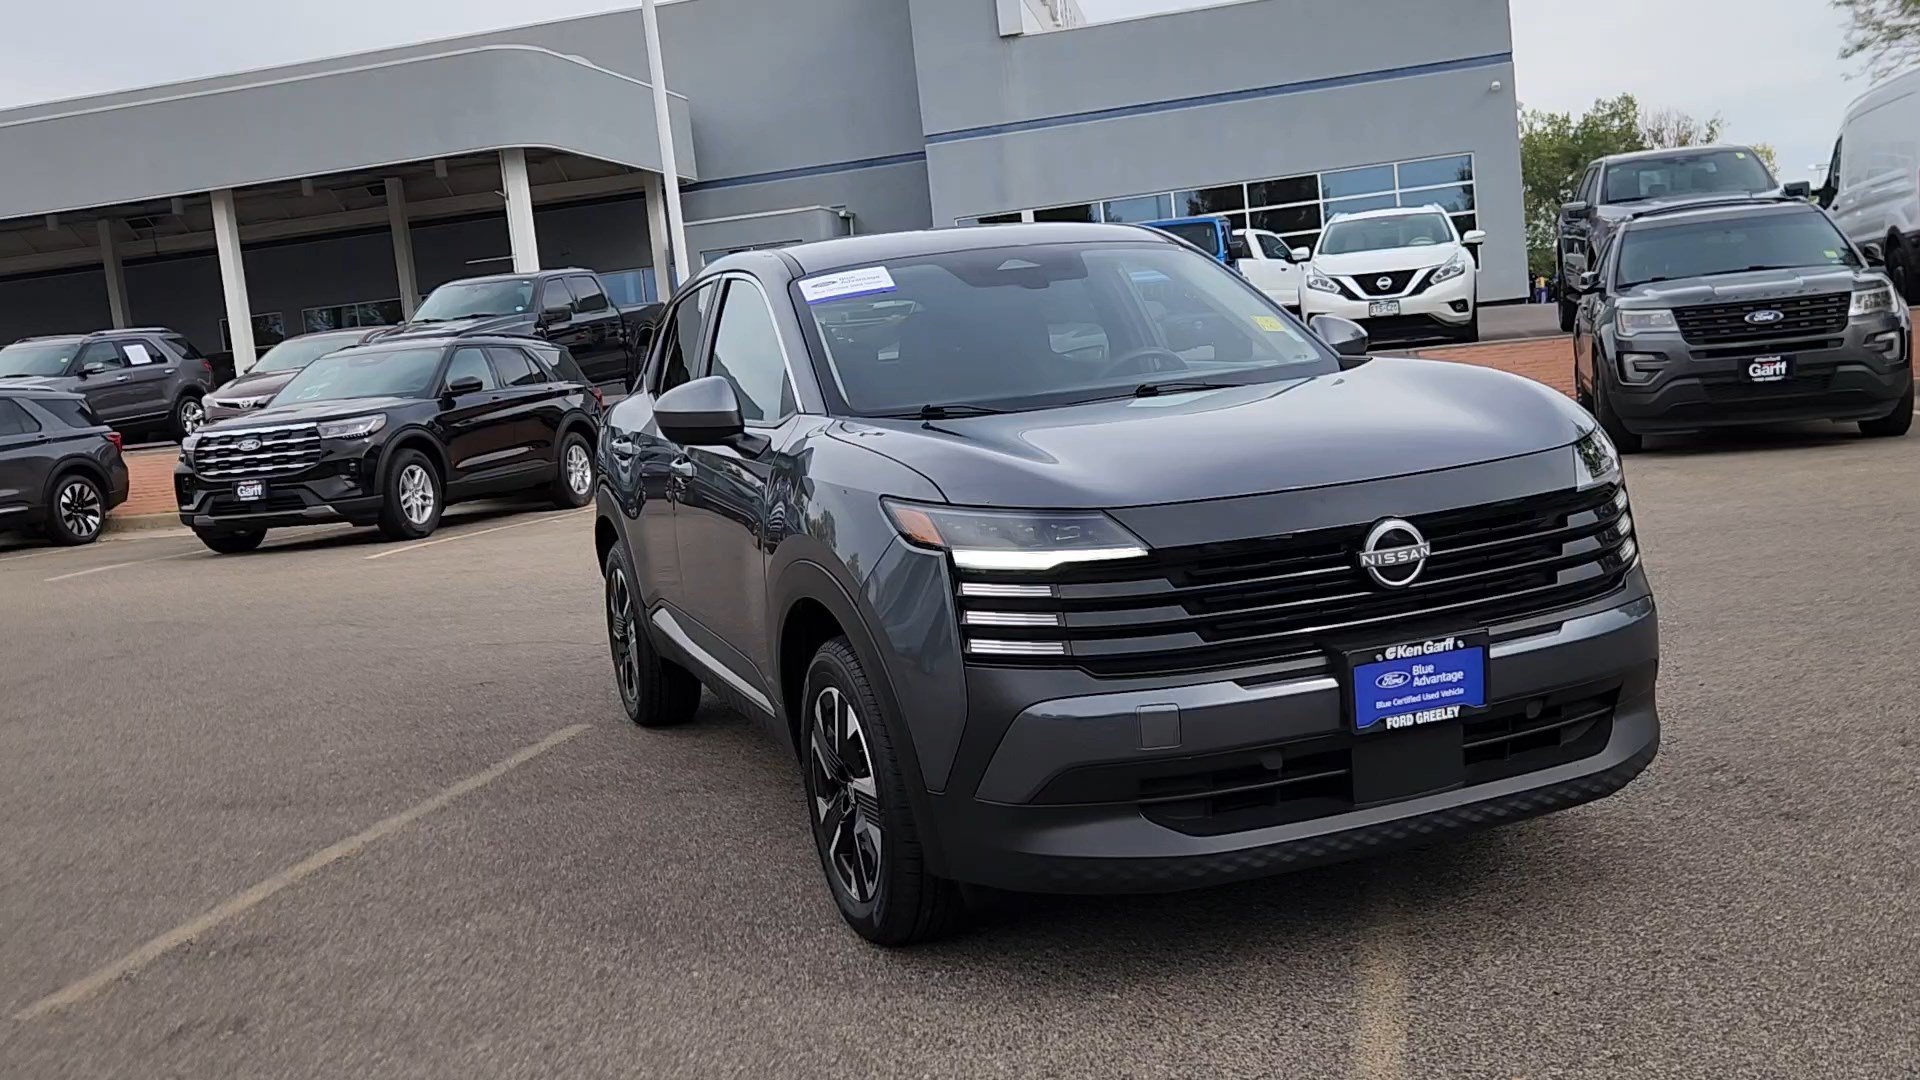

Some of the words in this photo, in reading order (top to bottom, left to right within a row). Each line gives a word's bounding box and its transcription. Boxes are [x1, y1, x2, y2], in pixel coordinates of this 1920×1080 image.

[1748, 361, 1787, 377] Garff
[237, 484, 262, 496] Garff
[1362, 546, 1430, 565] NISSAN
[1397, 644, 1422, 659] Ken
[1423, 637, 1455, 654] Garff
[1412, 664, 1434, 675] Blue
[1380, 674, 1405, 687] Ford
[1413, 670, 1464, 687] Advantage
[1376, 700, 1392, 709] Blue
[1393, 695, 1422, 707] Certified
[1423, 691, 1440, 701] Used
[1440, 687, 1464, 699] Vehicle
[1386, 713, 1414, 730] FORD
[1415, 706, 1460, 724] GREELEY
